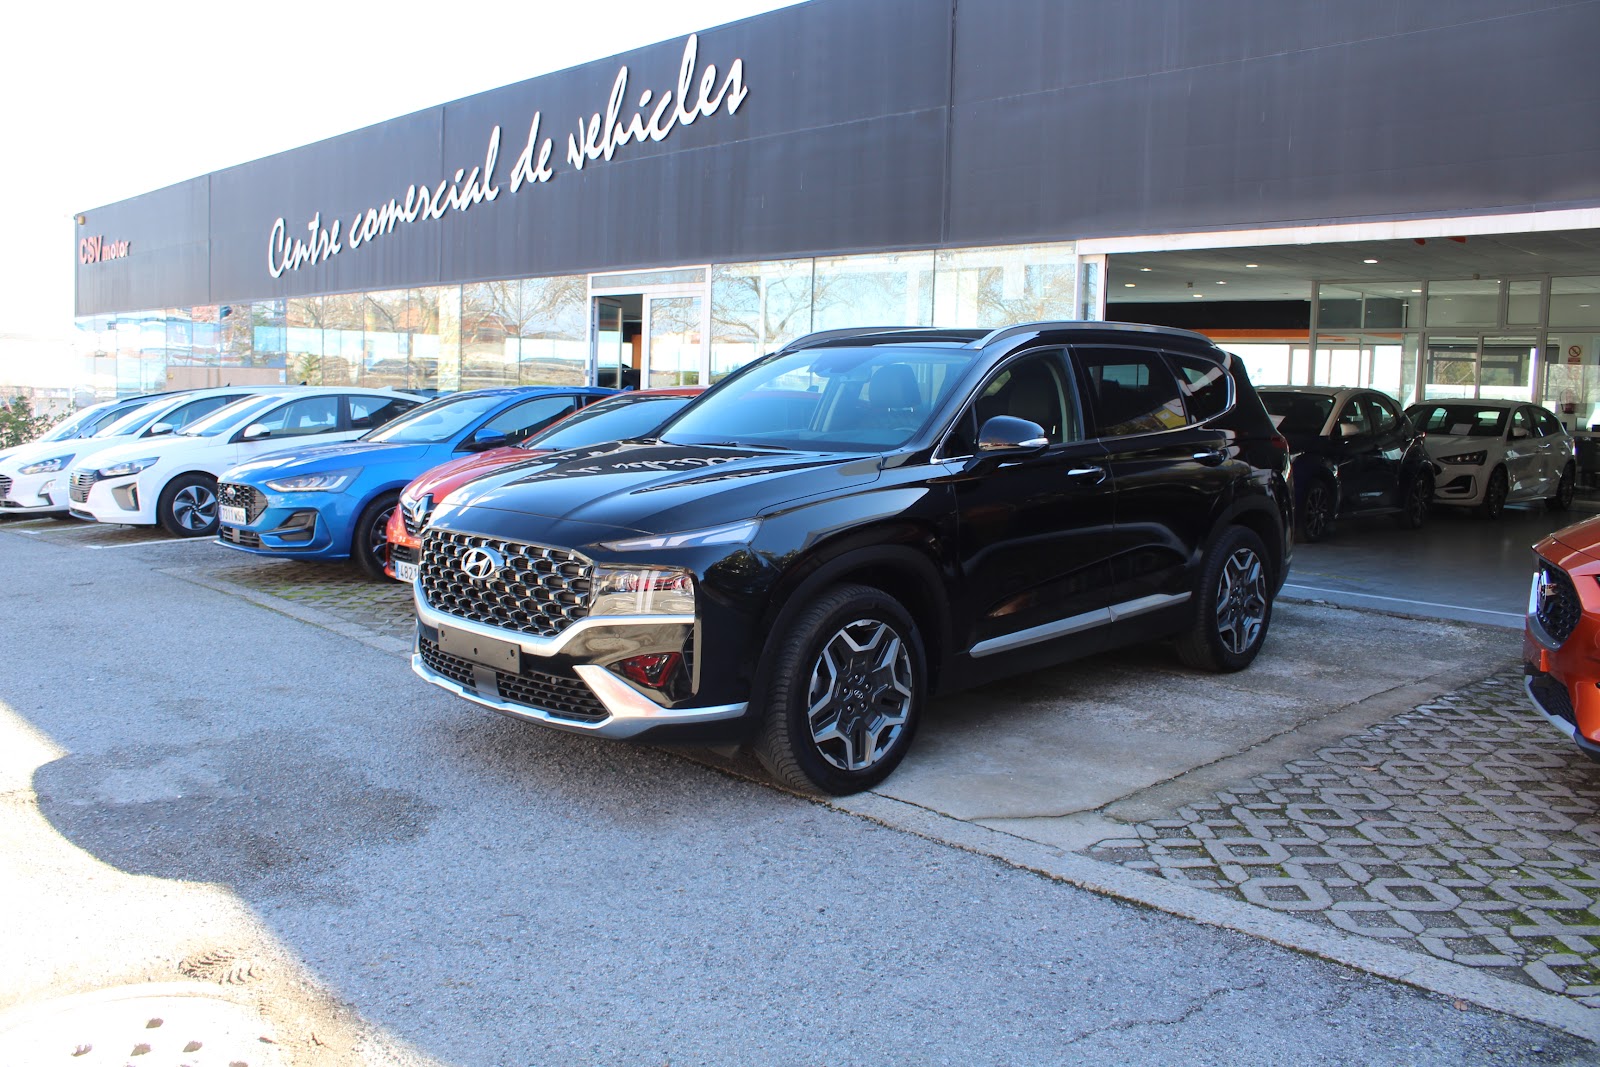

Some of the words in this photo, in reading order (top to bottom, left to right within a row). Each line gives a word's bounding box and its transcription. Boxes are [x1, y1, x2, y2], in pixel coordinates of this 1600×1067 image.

[268, 211, 342, 278] Centre
[349, 125, 500, 249] comercial
[510, 111, 553, 193] de
[567, 33, 748, 171] vehicles
[80, 235, 102, 264] CSV
[102, 240, 130, 261] motor
